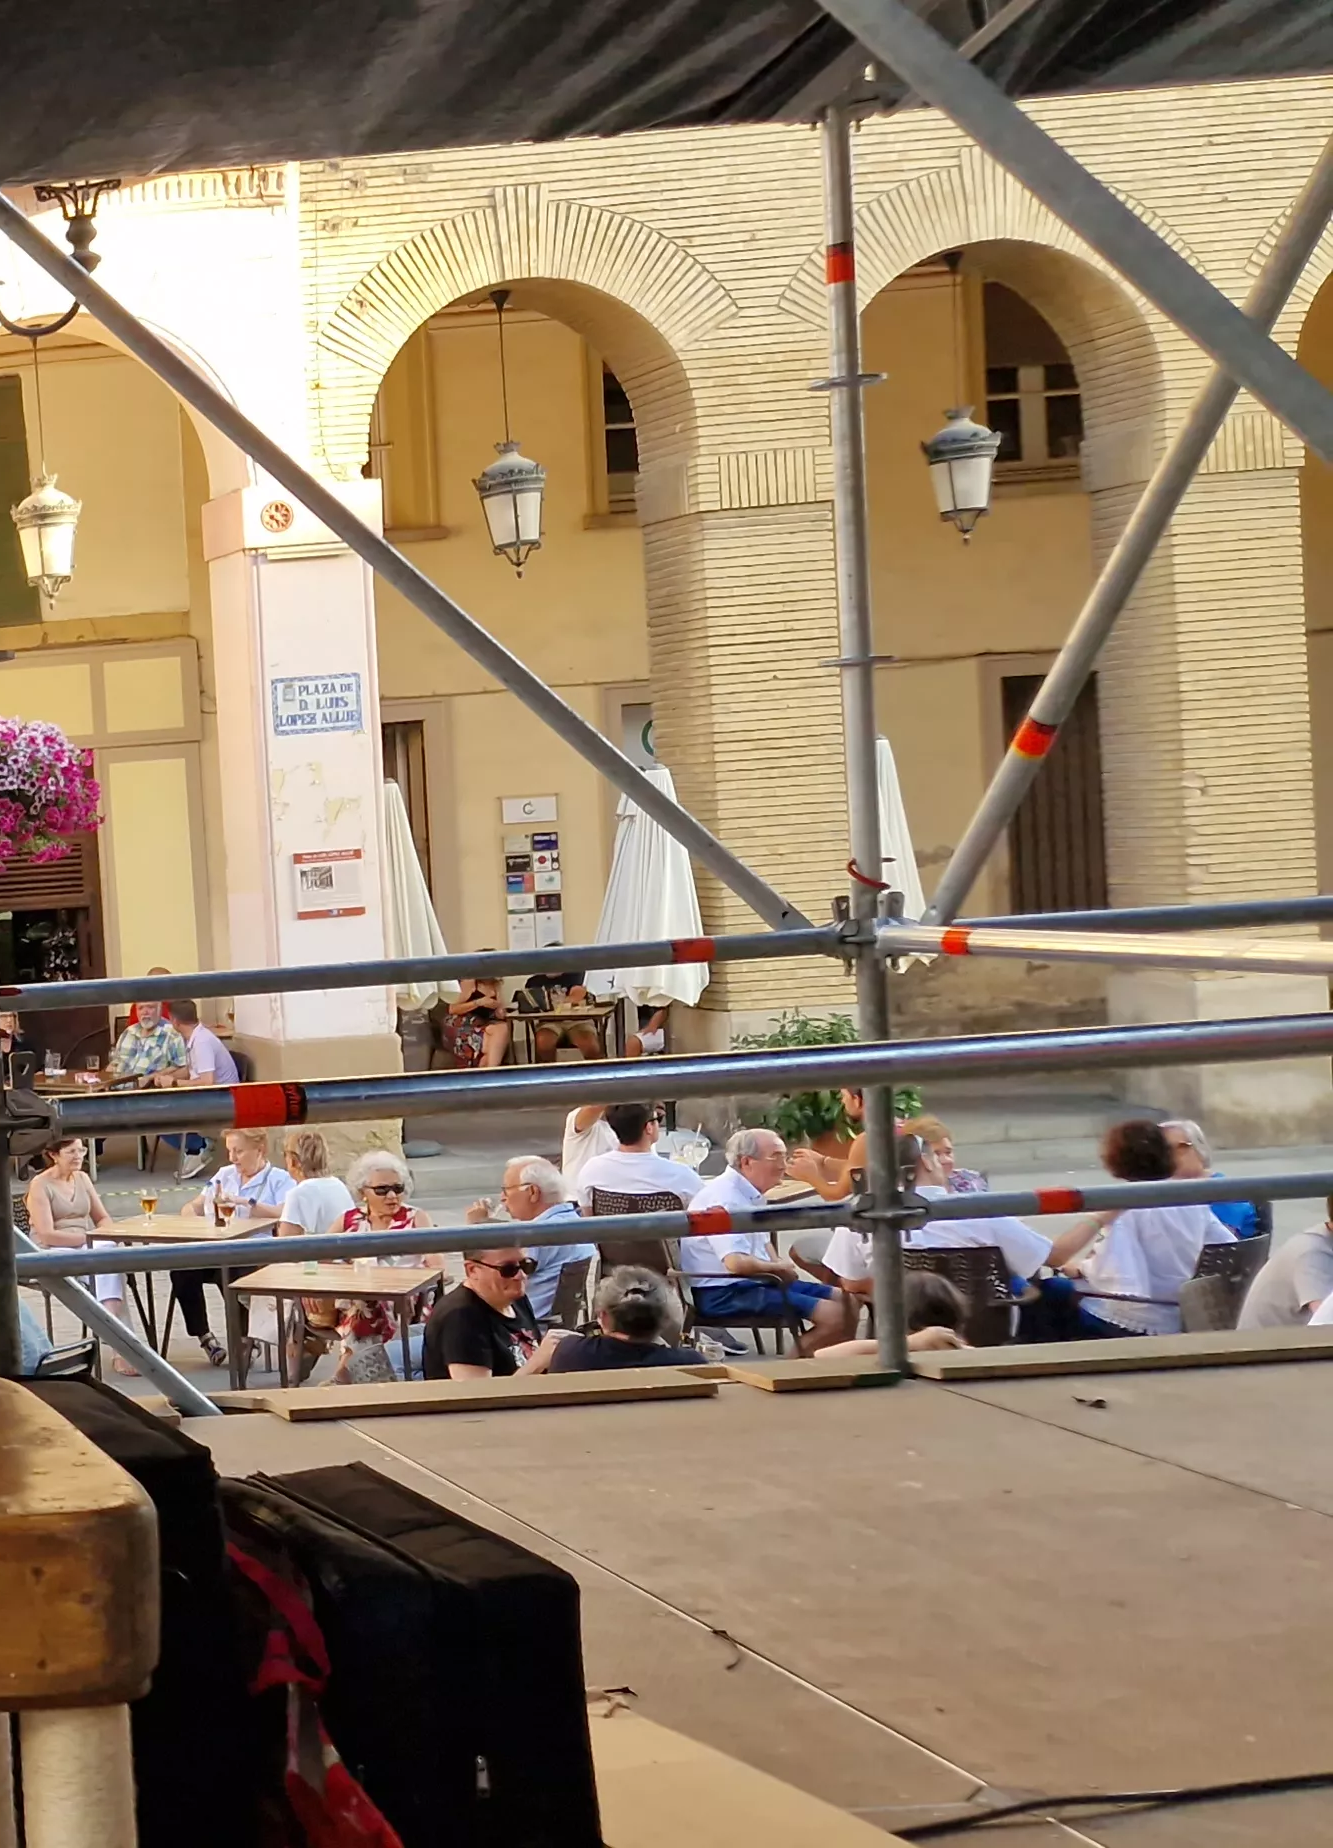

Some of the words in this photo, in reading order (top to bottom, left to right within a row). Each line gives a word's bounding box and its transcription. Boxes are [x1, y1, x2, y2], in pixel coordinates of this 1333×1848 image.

[298, 683, 337, 696] PLAZA
[340, 683, 353, 692] DE
[316, 697, 348, 709] LUIS
